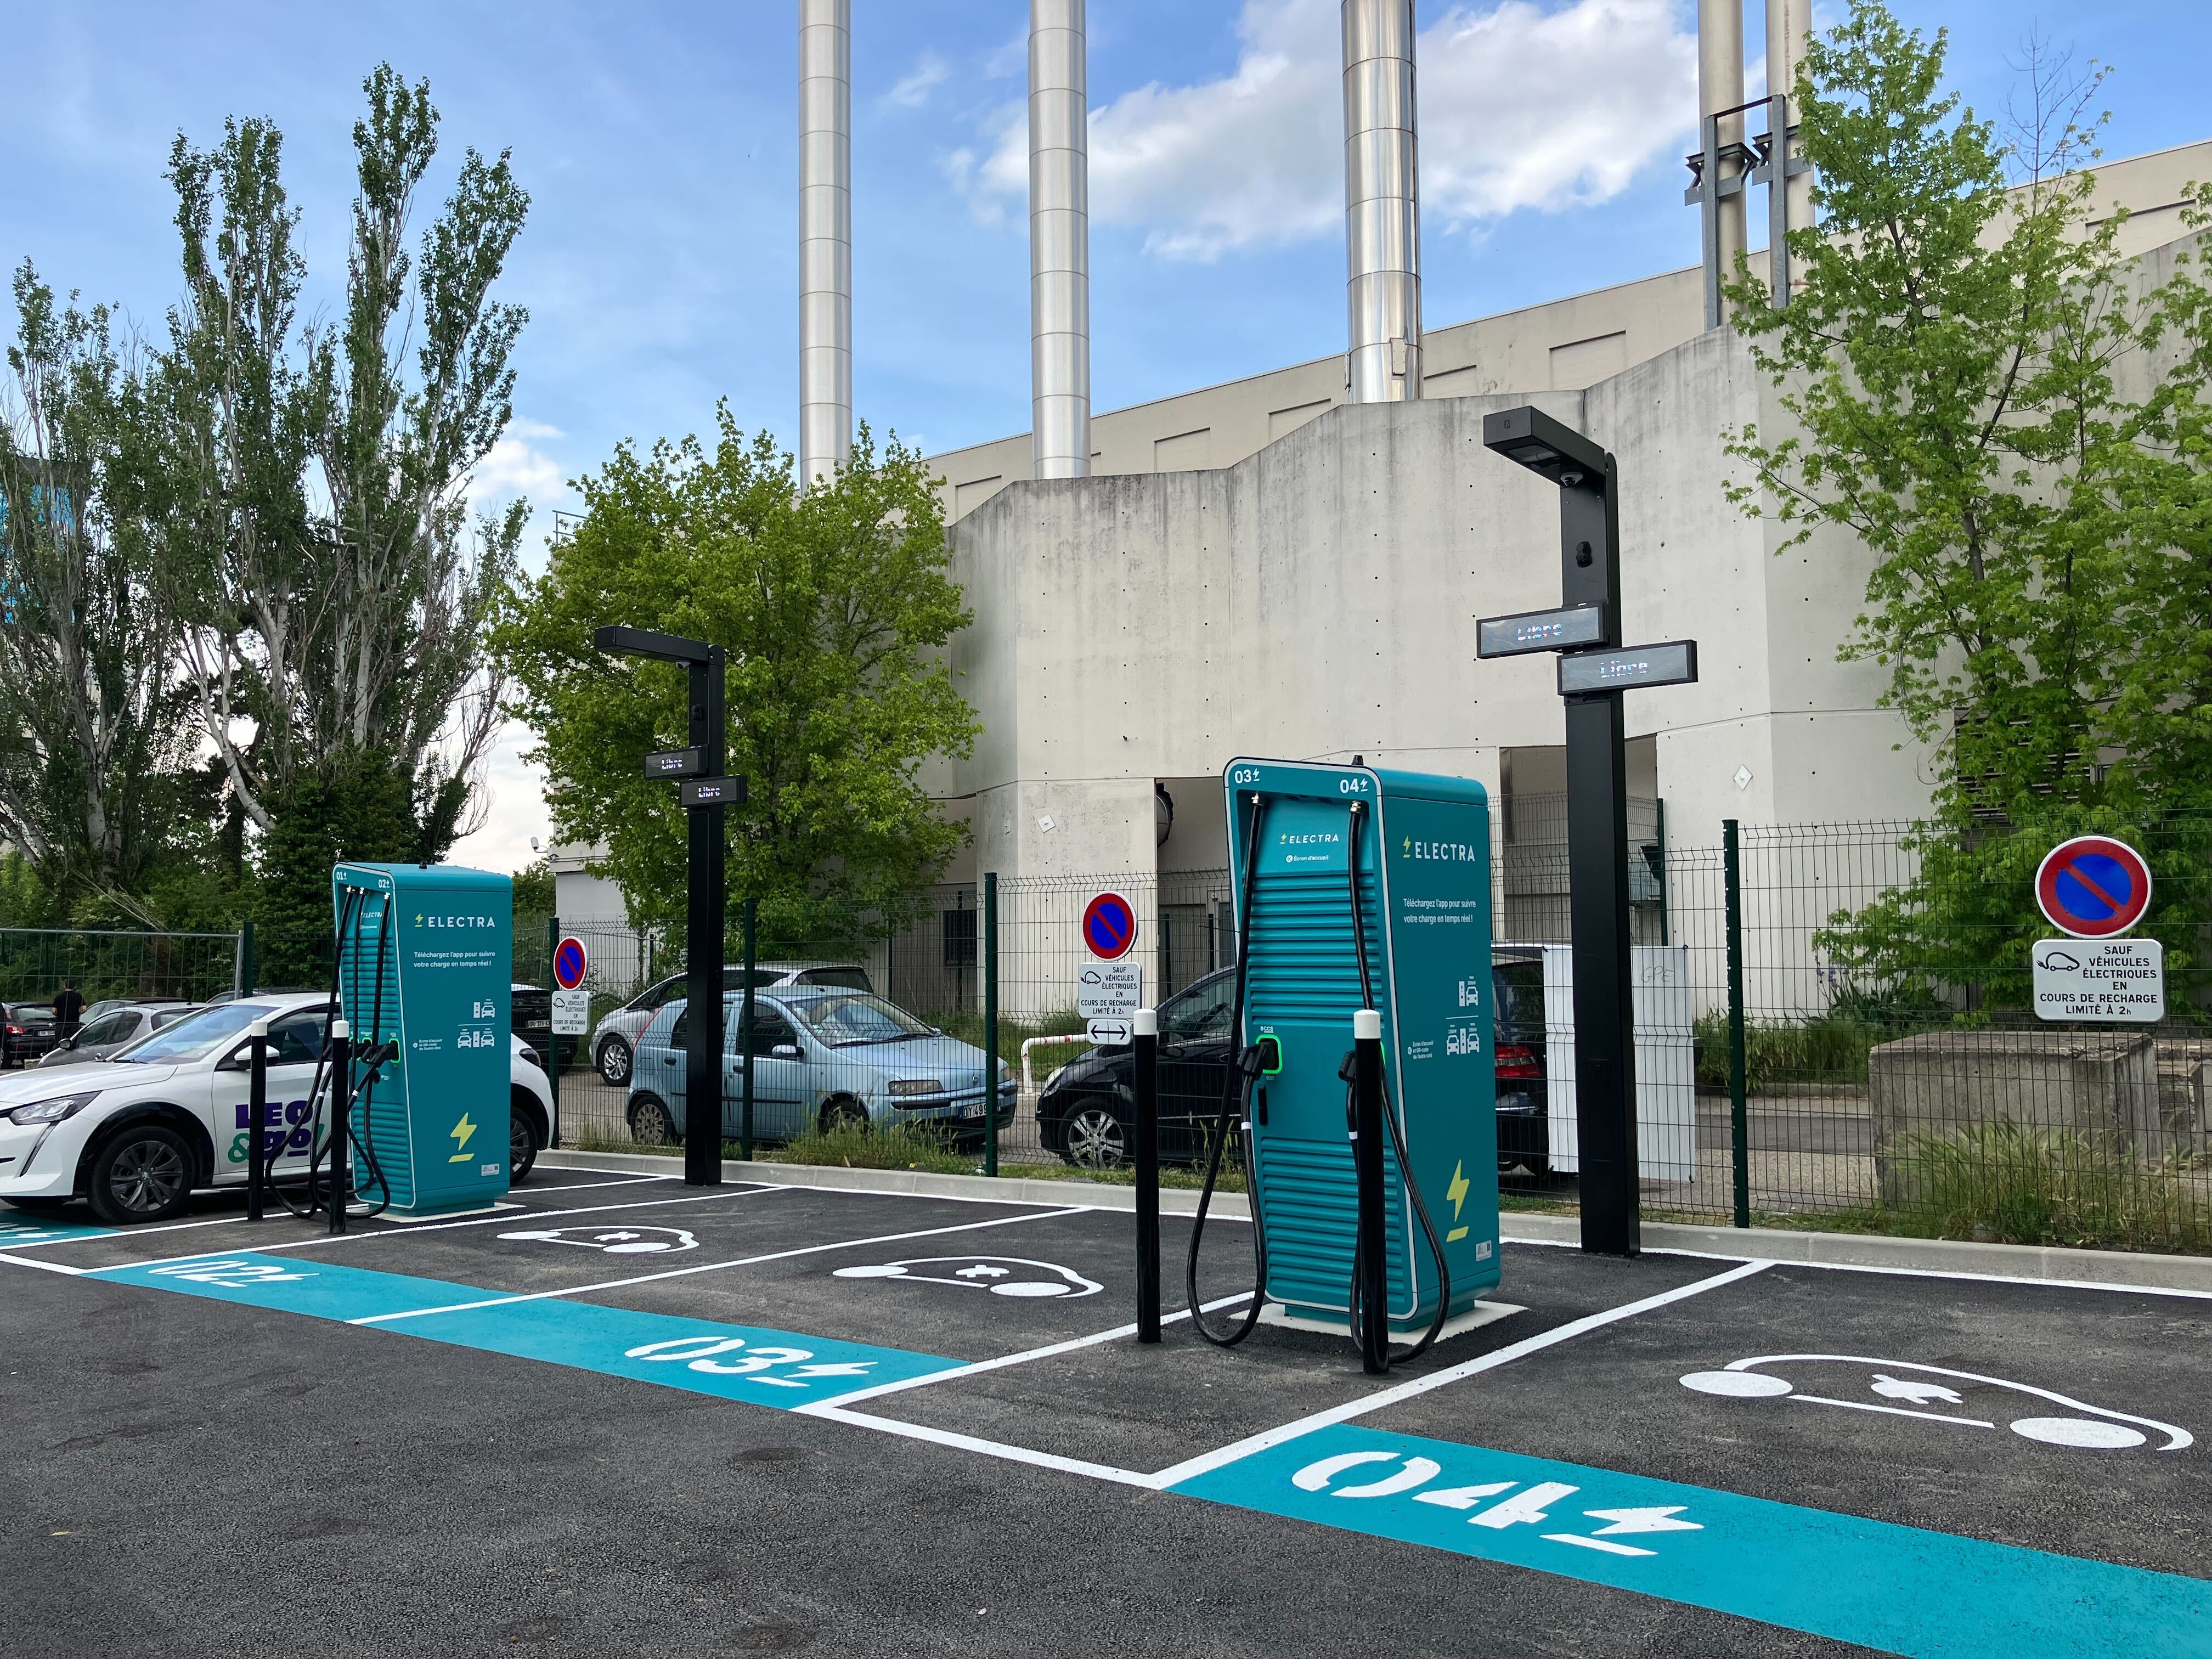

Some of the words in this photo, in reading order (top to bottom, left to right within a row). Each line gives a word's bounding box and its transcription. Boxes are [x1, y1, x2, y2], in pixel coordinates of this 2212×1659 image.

[1234, 769, 1252, 784] 03
[1340, 779, 1359, 793] 04
[1289, 834, 1339, 844] ELECTRA
[1415, 841, 1475, 862] ELECTRA
[336, 871, 344, 880] 01
[379, 879, 386, 888] 02
[1403, 898, 1435, 910] Téléchargez
[1436, 899, 1448, 910] l'app
[1449, 901, 1460, 910] pour
[1462, 899, 1476, 908] suivre
[428, 917, 495, 928] ELECTRA
[1404, 915, 1418, 923] votre
[1418, 914, 1436, 925] charge
[1444, 915, 1460, 924] temps
[2104, 946, 2132, 955] SAUF
[2089, 956, 2149, 966] VÉHICULES
[2083, 968, 2157, 979] ÉLECTRIQUES
[2113, 981, 2127, 990] EN
[2040, 994, 2075, 1002] COURS
[2080, 994, 2095, 1002] DE
[2100, 994, 2157, 1003] RECHARGE
[2066, 1004, 2101, 1014] LIMITÉ
[2107, 1004, 2113, 1014] À
[2119, 1006, 2131, 1015] 2h
[235, 1100, 313, 1129] LEO
[148, 1261, 285, 1282] 02
[624, 1336, 814, 1374] 03
[1292, 1452, 1581, 1530] 04
